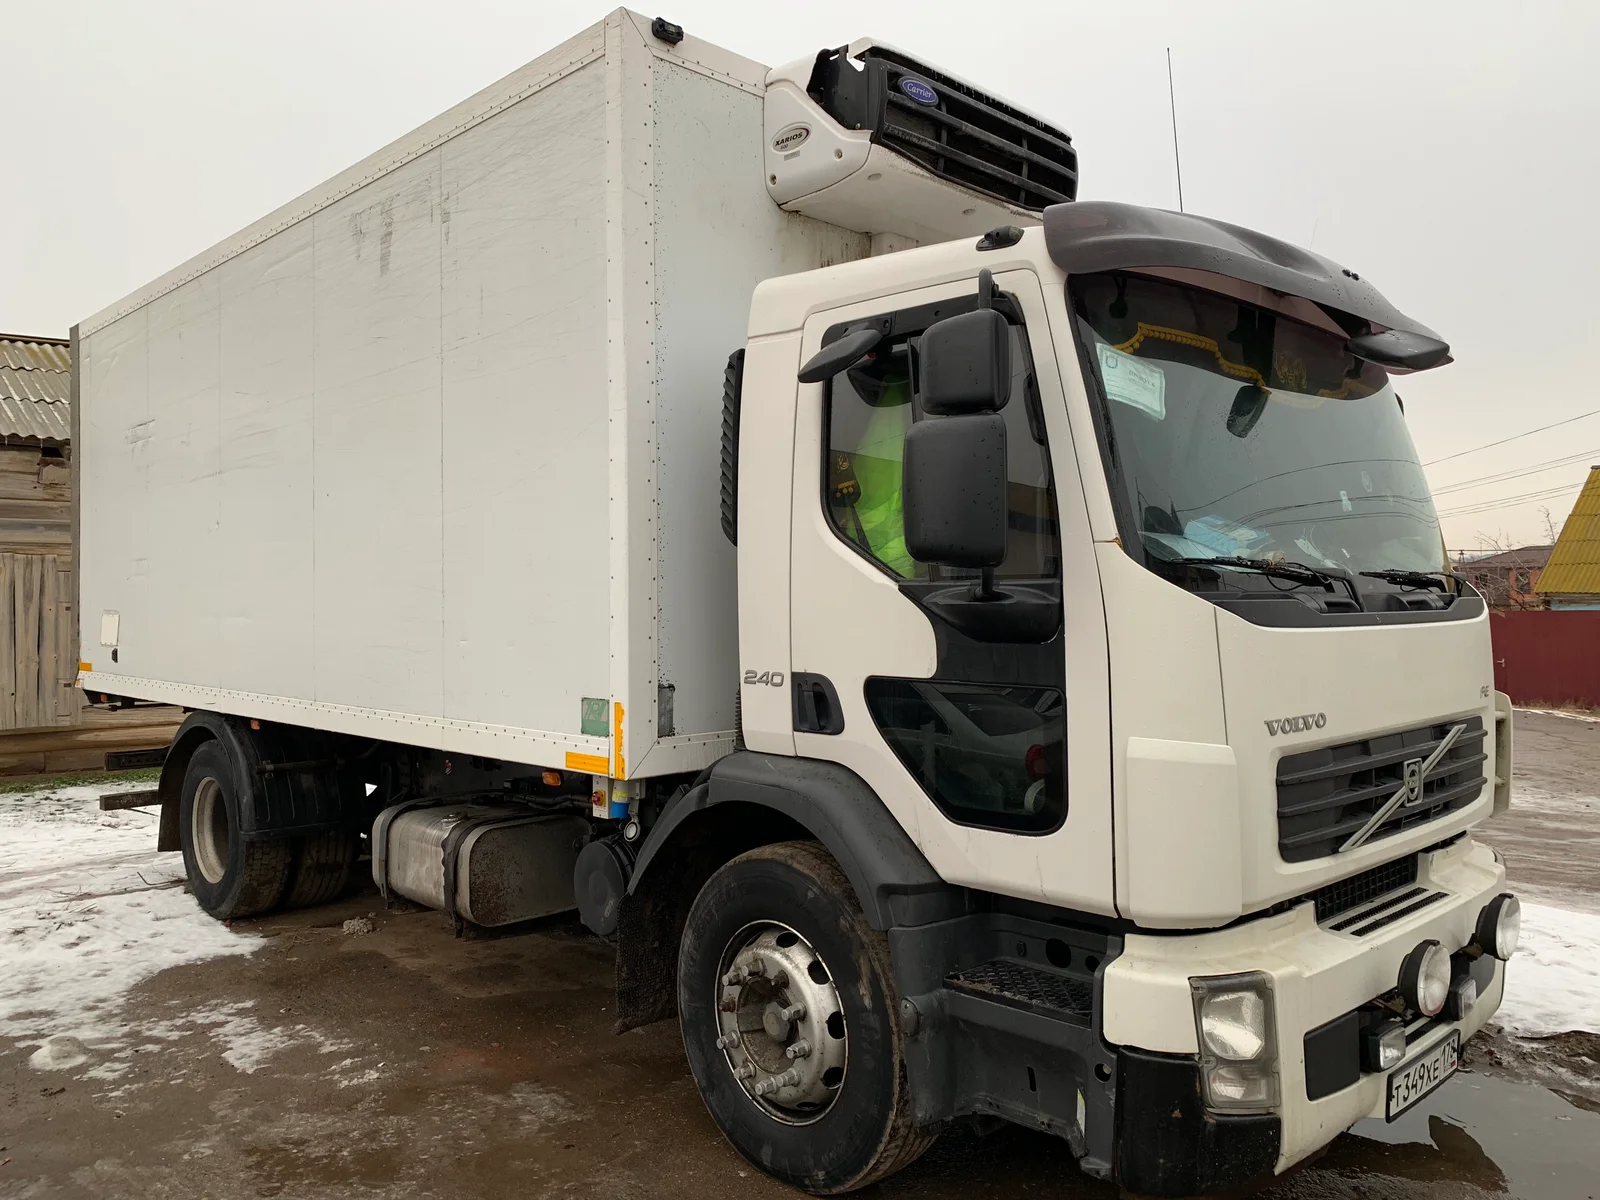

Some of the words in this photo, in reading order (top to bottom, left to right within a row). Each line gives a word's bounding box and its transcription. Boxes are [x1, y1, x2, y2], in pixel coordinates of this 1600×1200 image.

[907, 82, 932, 98] Carrier
[775, 131, 803, 147] XARIOS
[743, 669, 785, 687] 240
[1263, 712, 1327, 737] VOLVO
